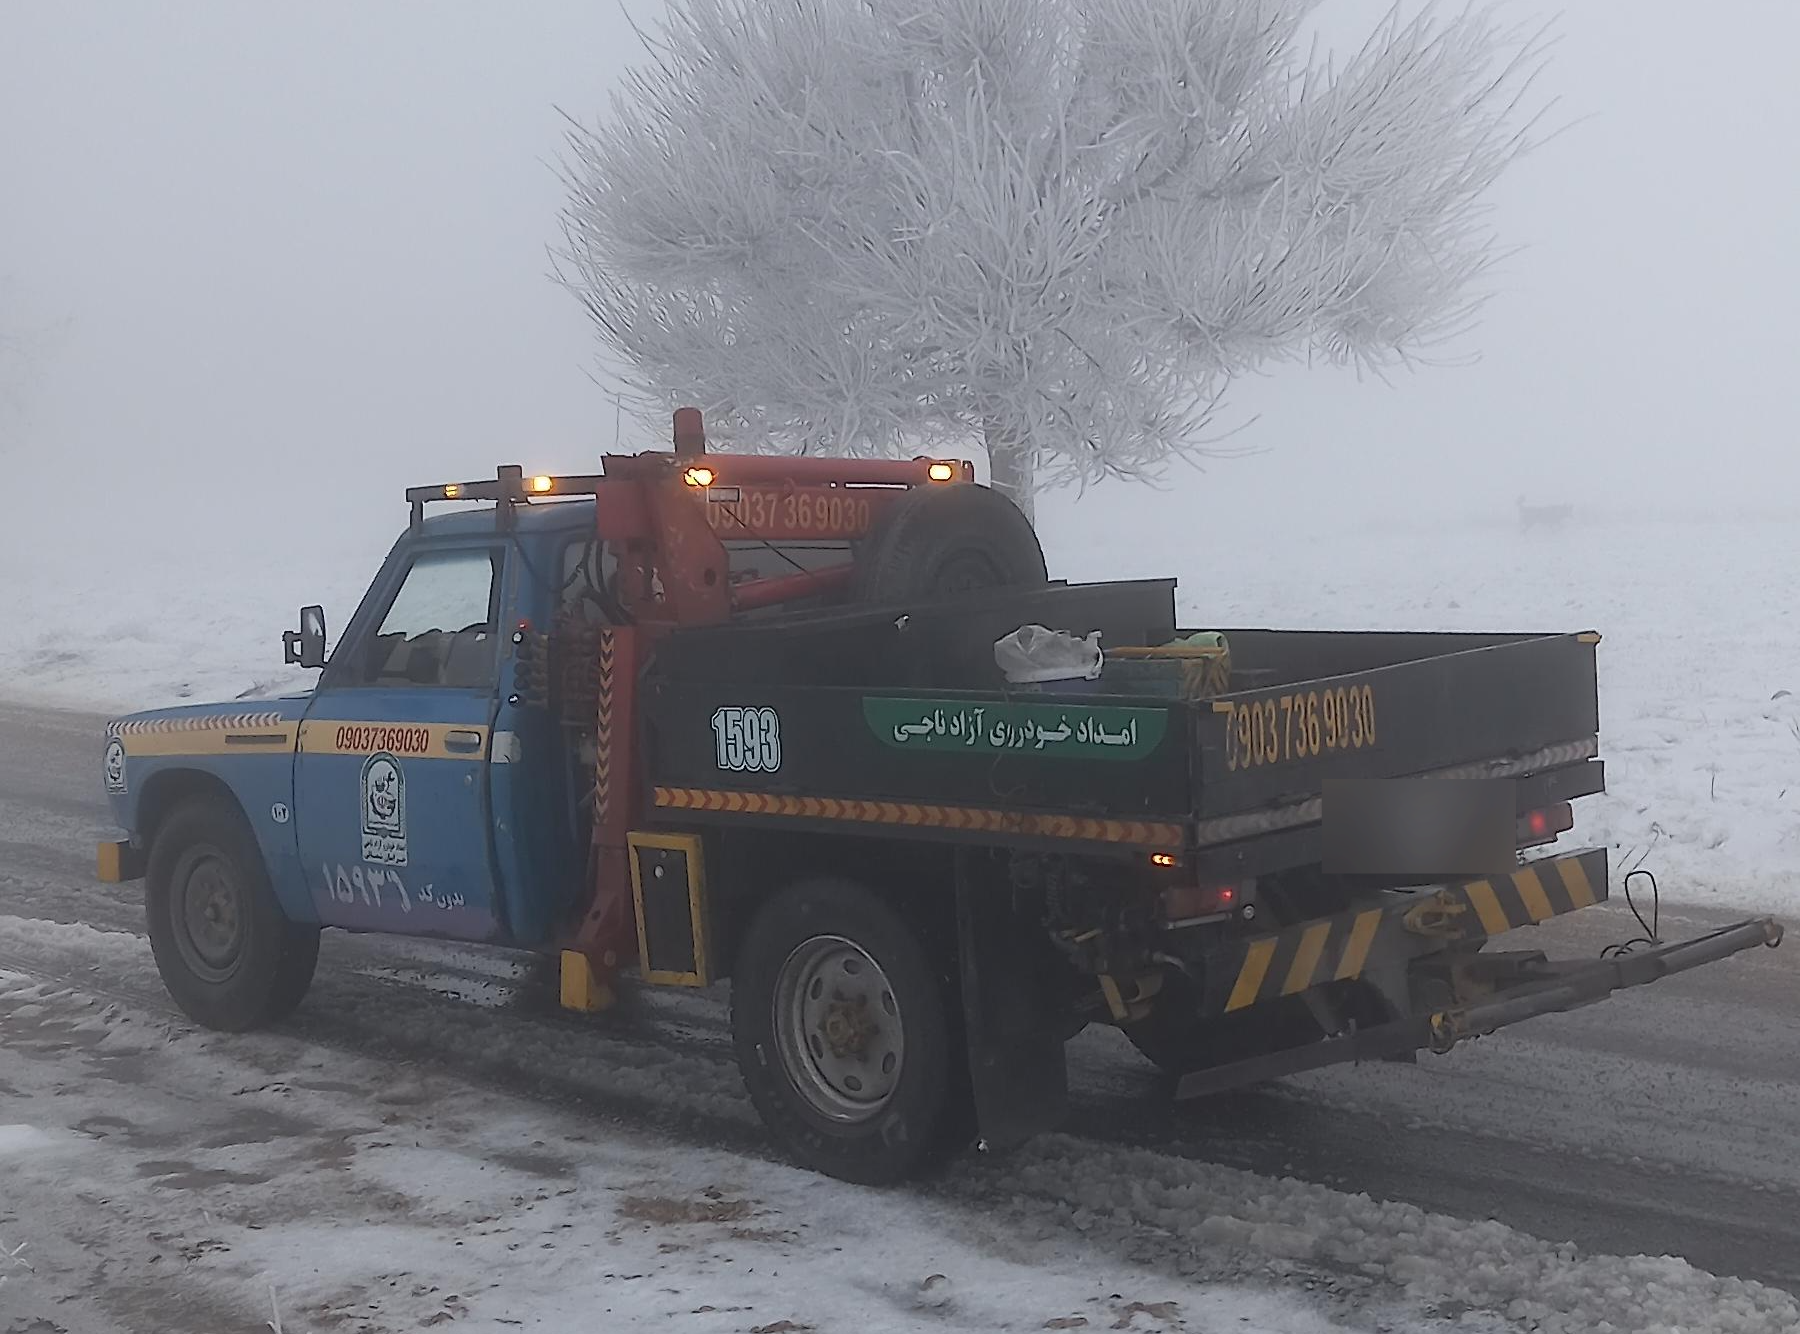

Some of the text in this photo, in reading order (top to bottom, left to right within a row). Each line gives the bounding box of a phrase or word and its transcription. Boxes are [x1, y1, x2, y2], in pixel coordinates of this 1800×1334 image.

[336, 726, 429, 753] 09037369030
[712, 707, 780, 772] 1593
[894, 709, 946, 742] ناجی
[950, 708, 985, 746] آزاد
[1076, 717, 1137, 746] امداد
[418, 883, 433, 903] کد
